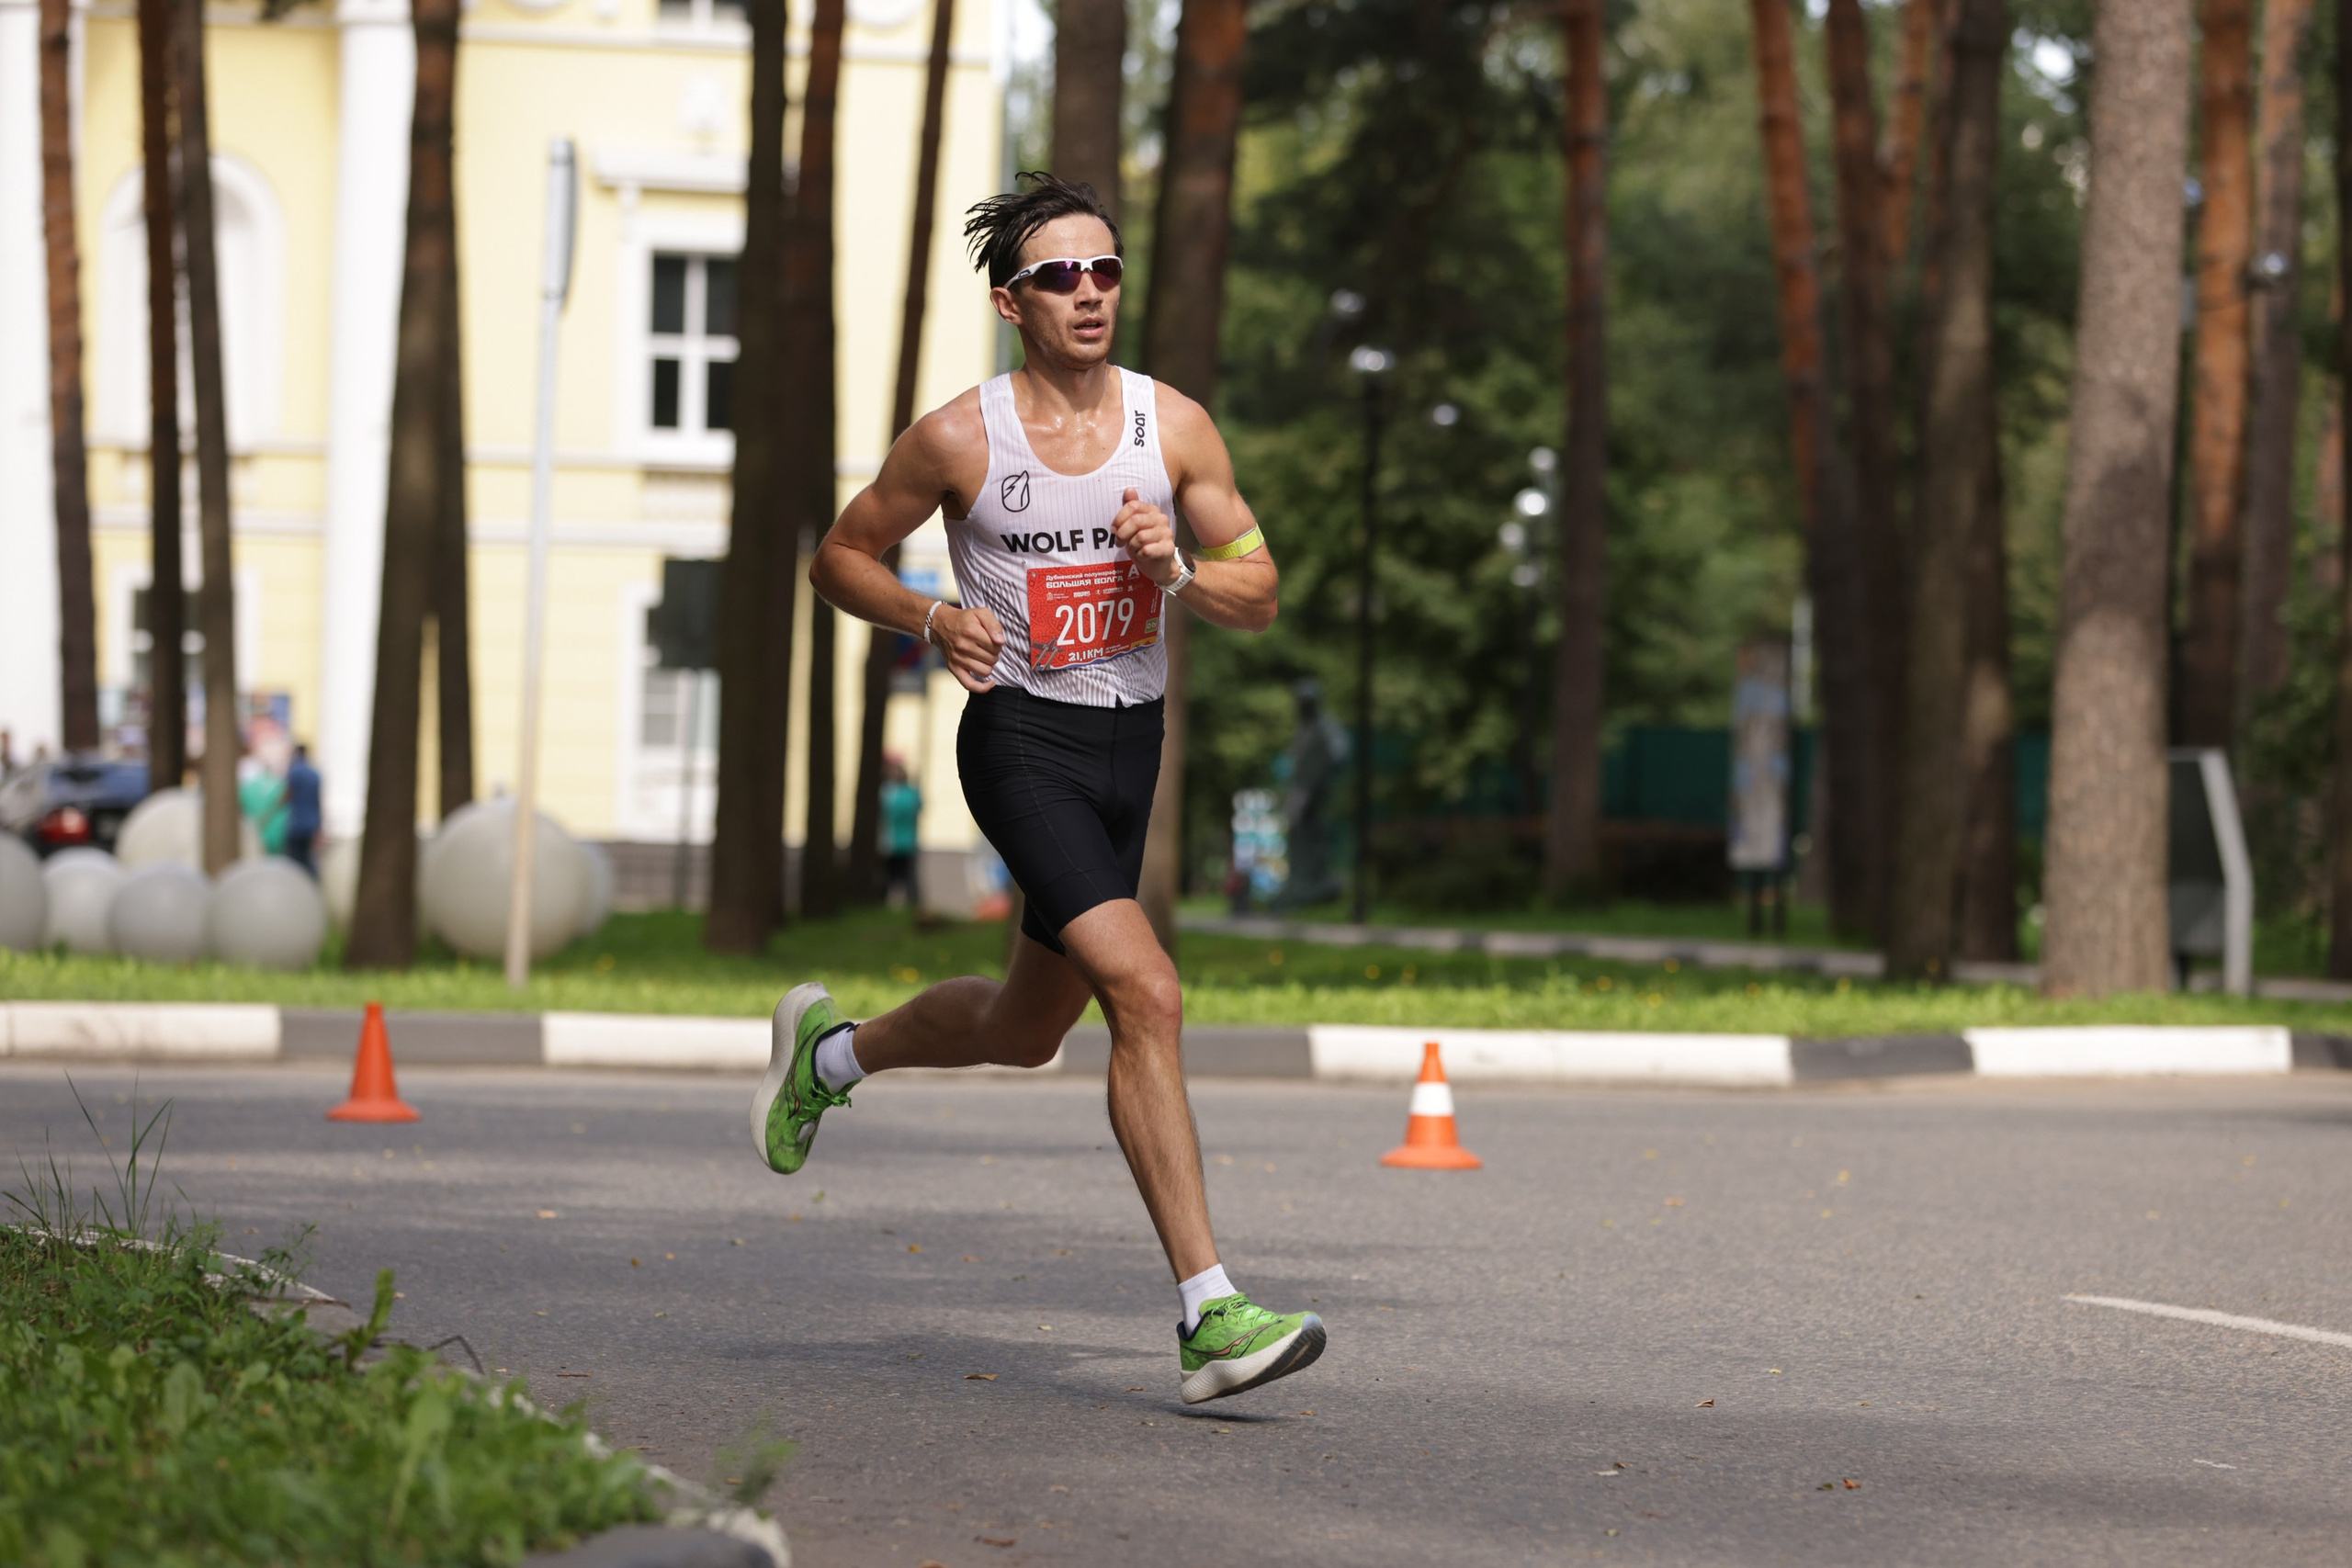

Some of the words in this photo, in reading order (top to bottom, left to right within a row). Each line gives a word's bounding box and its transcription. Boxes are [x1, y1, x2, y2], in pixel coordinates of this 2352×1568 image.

[1134, 410, 1146, 447] soar
[1000, 529, 1084, 554] WOLF
[1046, 579, 1091, 589] БОЛЬШАЯ
[1093, 575, 1124, 585] ВОЛГА
[1055, 597, 1135, 646] 2079
